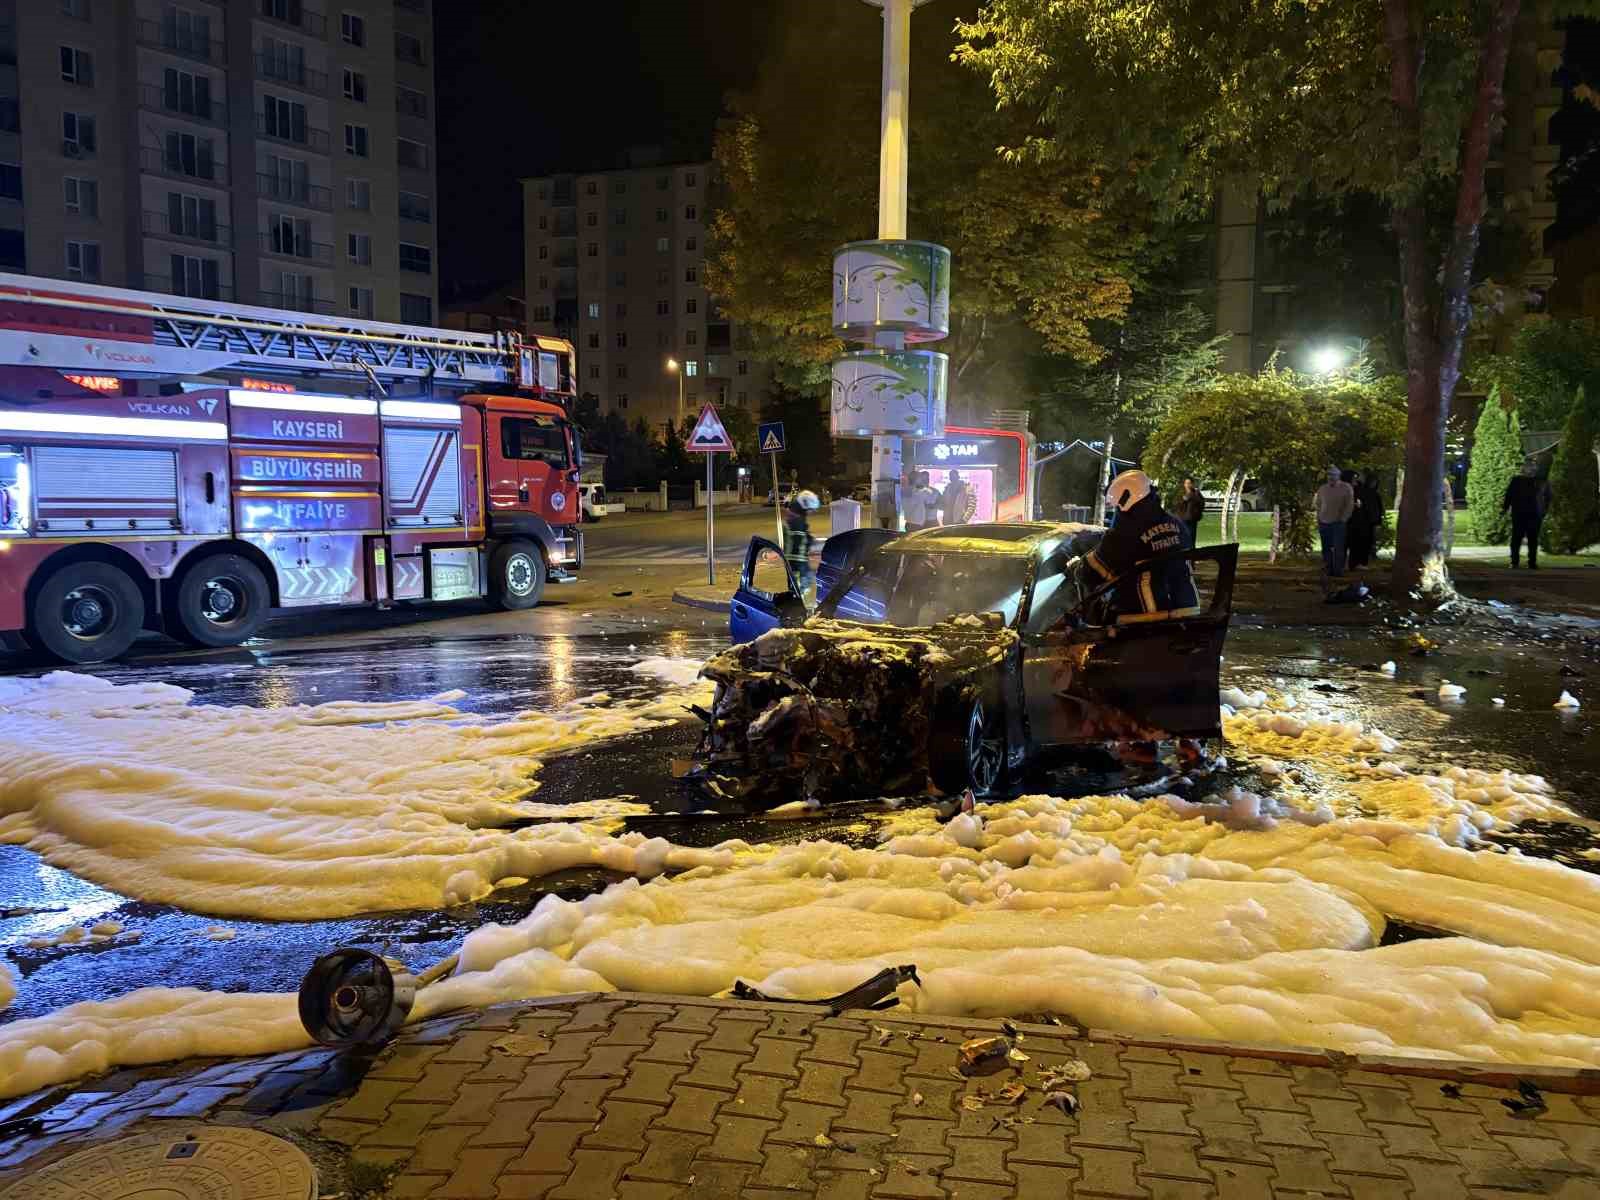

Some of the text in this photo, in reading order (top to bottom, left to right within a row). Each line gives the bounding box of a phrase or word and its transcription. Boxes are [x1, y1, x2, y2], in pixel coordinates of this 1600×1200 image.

[128, 401, 190, 416] VOLKAN
[272, 420, 344, 439] KAYSERİ
[950, 444, 979, 456] TAM
[252, 457, 363, 480] BÜYÜKŞEHİR
[274, 500, 345, 519] İTFAİYE
